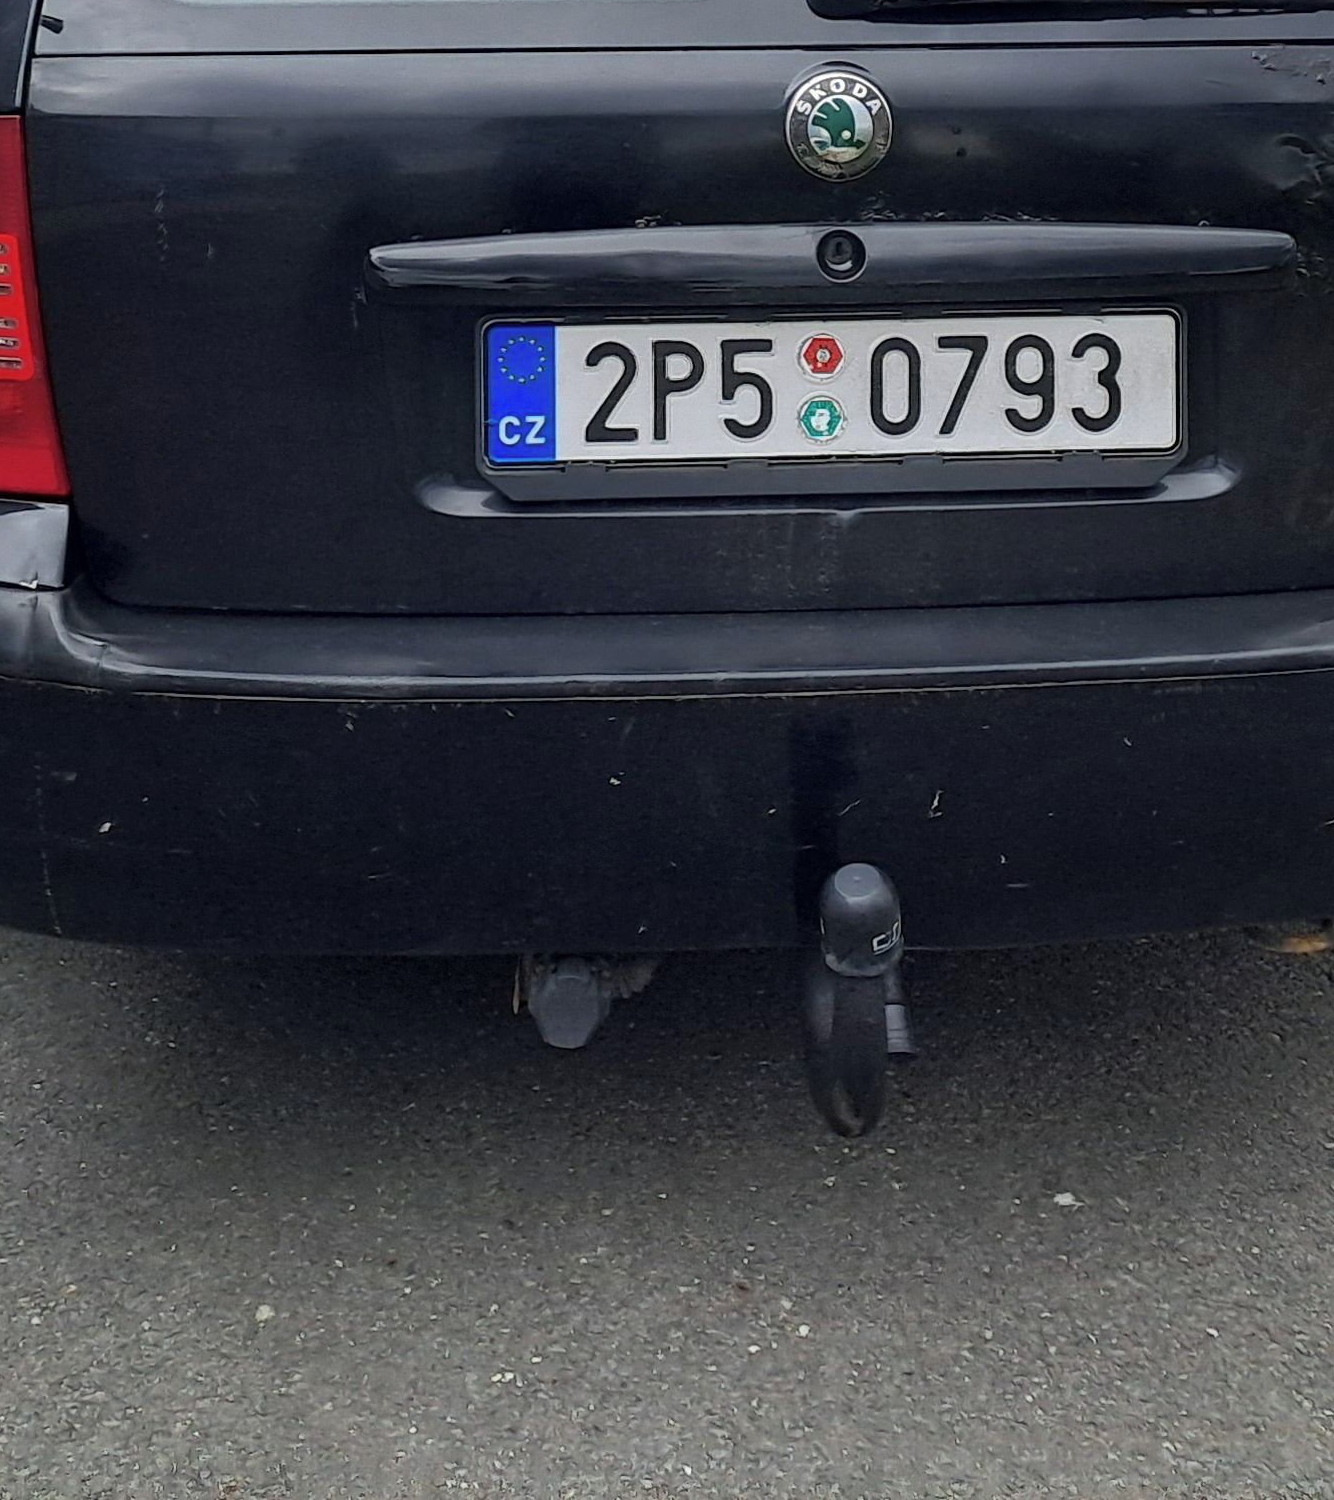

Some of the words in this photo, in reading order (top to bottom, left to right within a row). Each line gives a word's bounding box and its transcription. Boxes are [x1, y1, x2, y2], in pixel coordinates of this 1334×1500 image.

[584, 338, 774, 442] 2P5
[868, 333, 1122, 437] 0793
[497, 414, 546, 445] CZ
